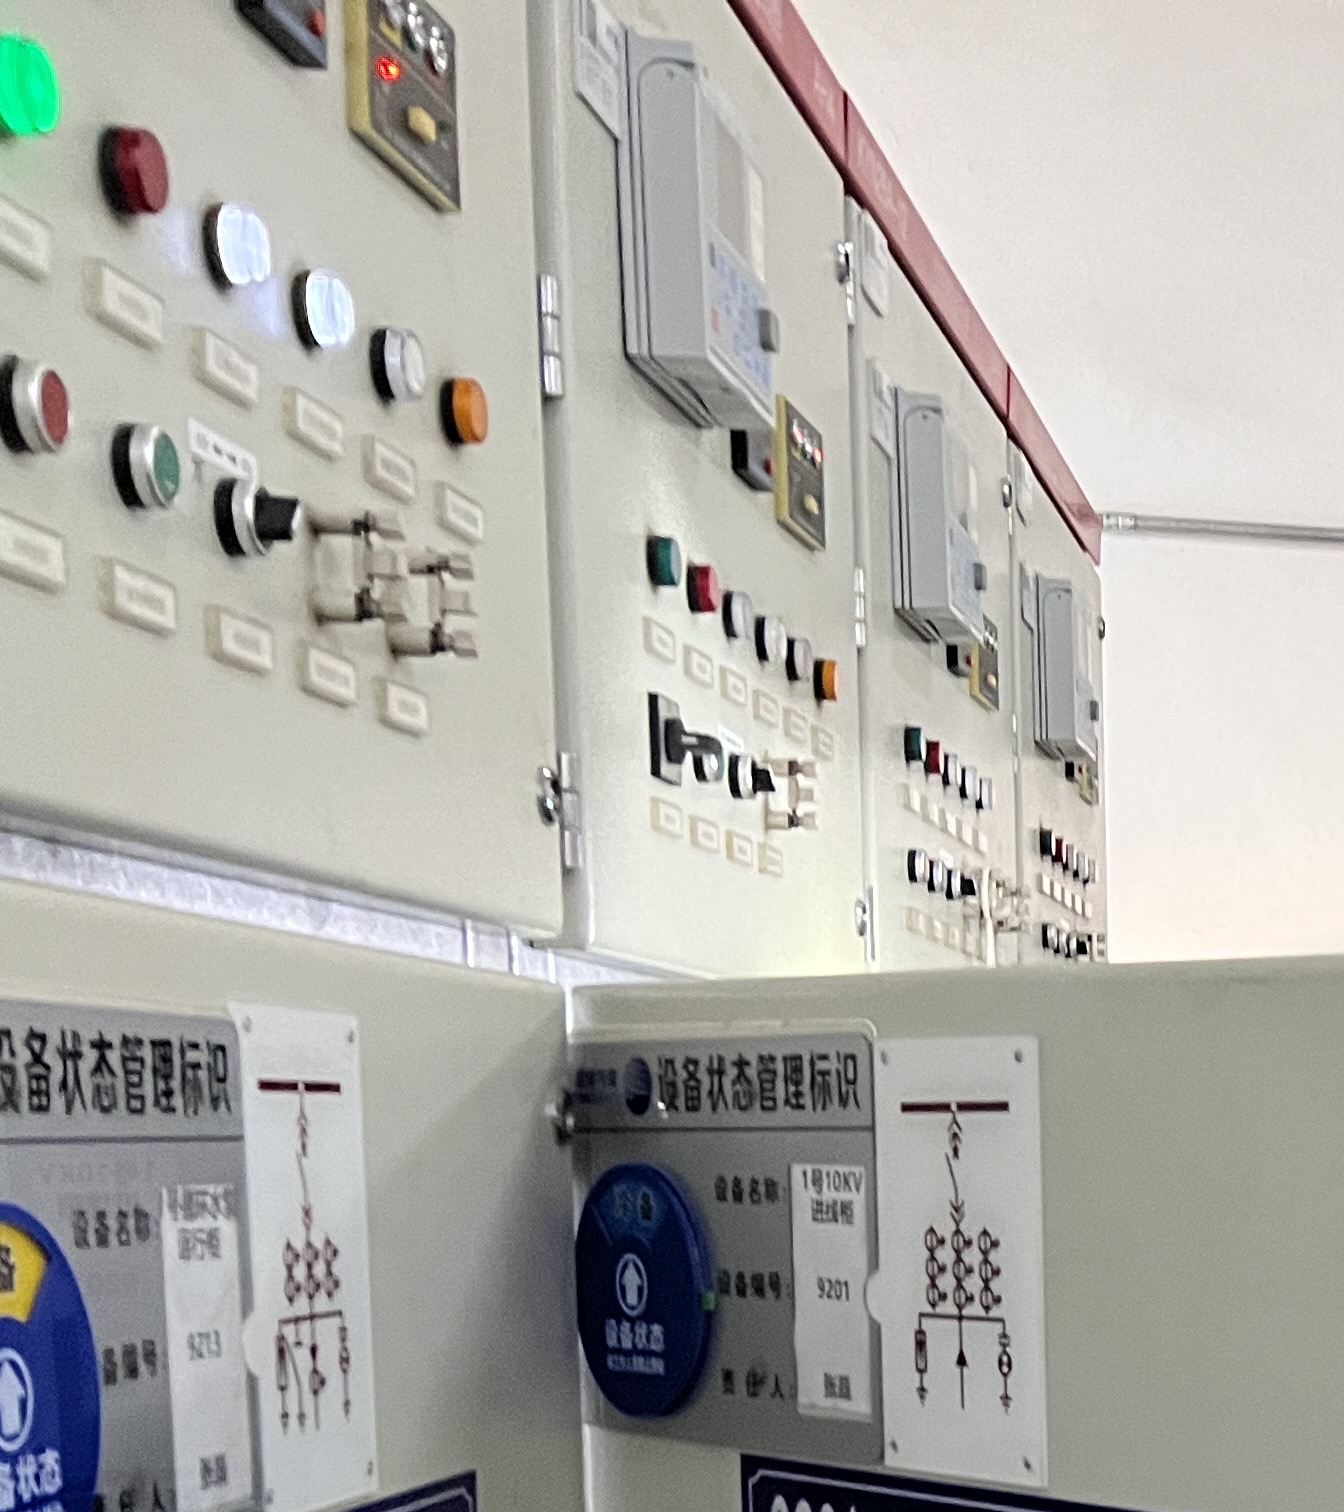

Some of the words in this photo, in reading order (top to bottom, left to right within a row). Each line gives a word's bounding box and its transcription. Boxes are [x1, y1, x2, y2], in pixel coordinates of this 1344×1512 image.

[657, 1051, 861, 1112] 设备状态管理标识
[816, 1276, 851, 1302] 9201
